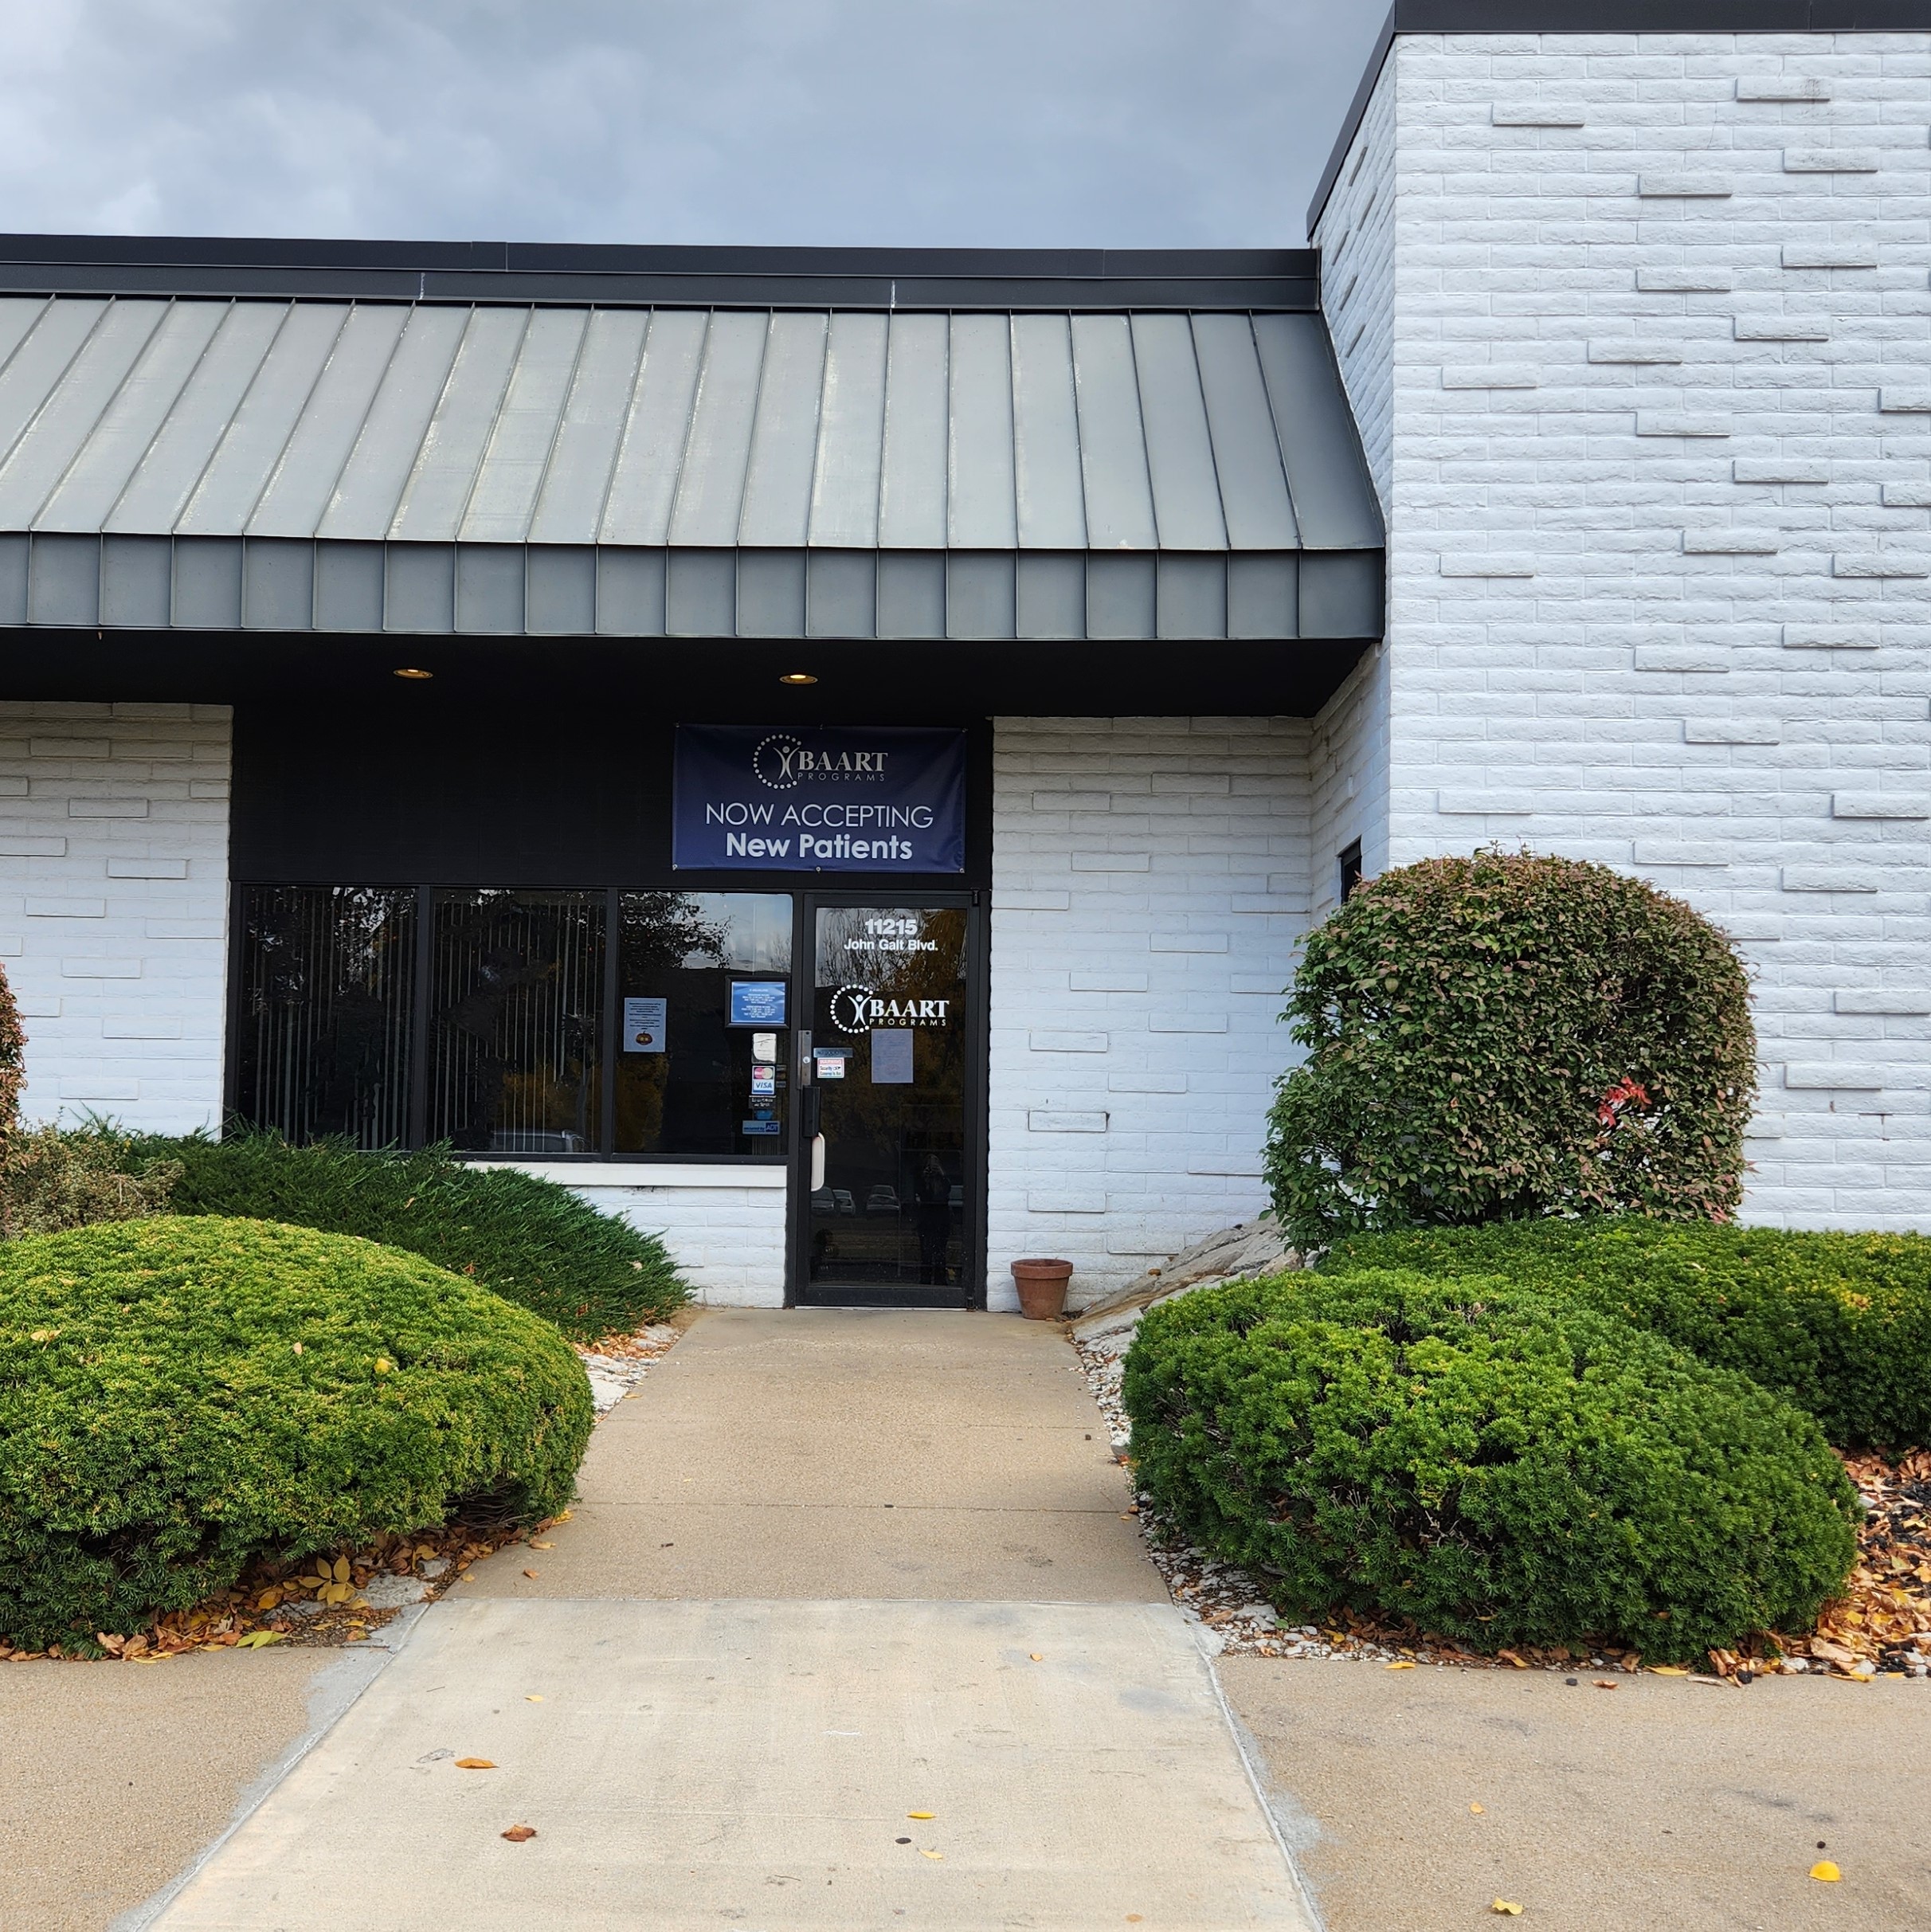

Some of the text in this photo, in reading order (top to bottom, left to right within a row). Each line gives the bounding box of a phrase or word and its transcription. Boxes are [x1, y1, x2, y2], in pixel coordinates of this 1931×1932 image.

[797, 750, 888, 771] BAART
[797, 772, 885, 782] PROGRAMS
[705, 802, 934, 829] NOW ACCEPTING
[726, 833, 913, 860] New Patients
[865, 919, 918, 935] 11215
[844, 938, 938, 951] John Galt Blvd.
[869, 999, 950, 1017] BAART
